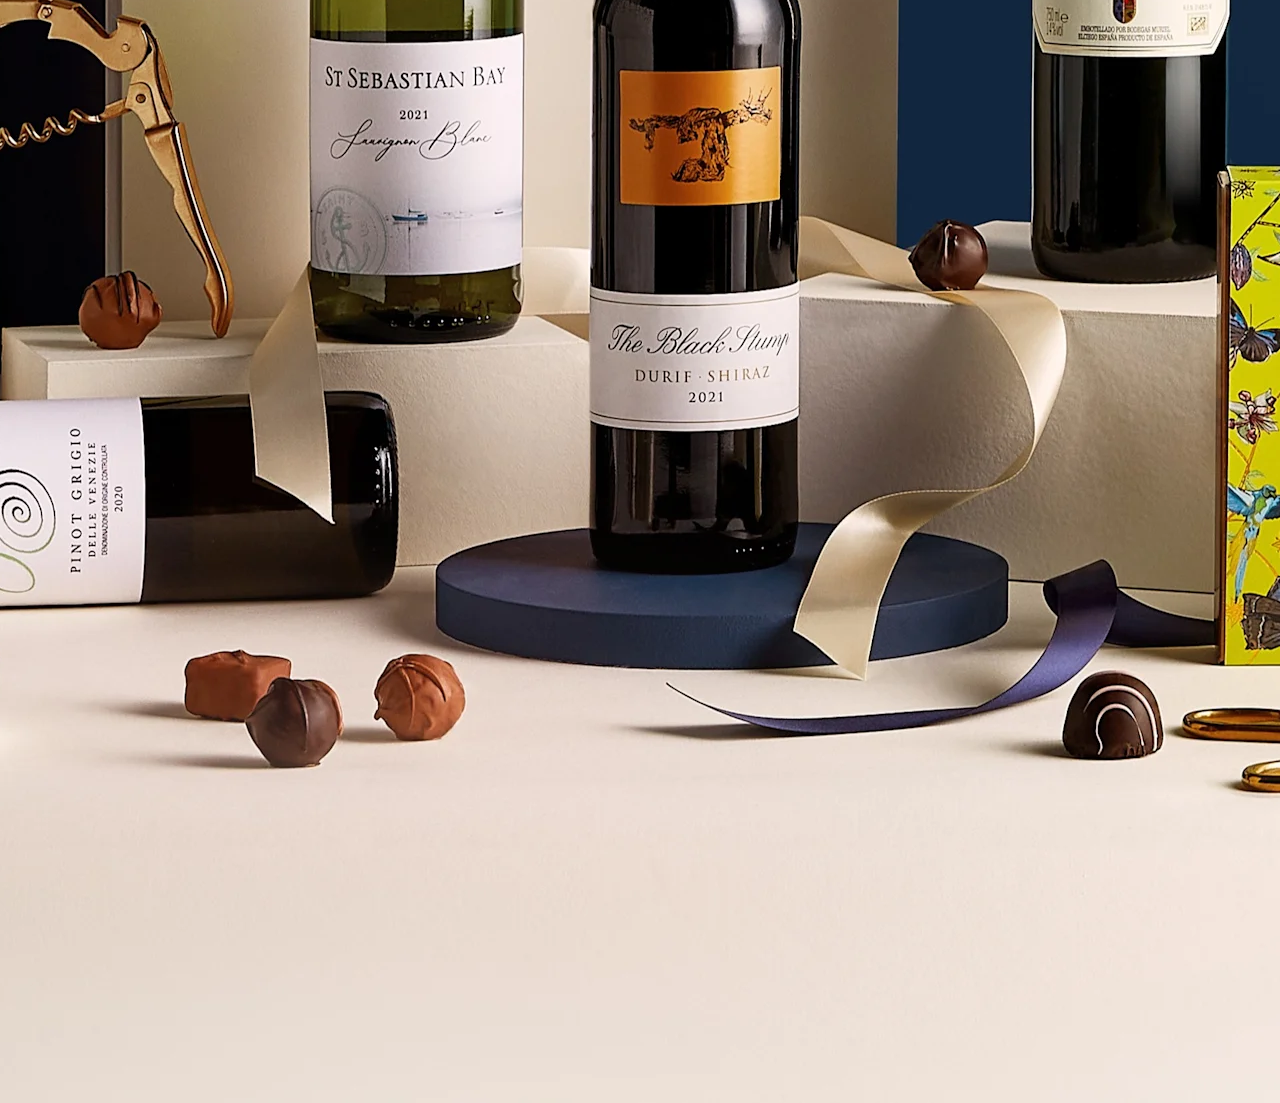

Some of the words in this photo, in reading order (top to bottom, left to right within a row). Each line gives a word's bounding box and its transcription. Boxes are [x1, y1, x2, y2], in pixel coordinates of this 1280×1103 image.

[347, 68, 465, 90] SEBASTIAN
[472, 66, 506, 88] BAY
[399, 109, 429, 121] 2021
[330, 119, 420, 162] Sauvignon
[419, 120, 492, 160] Blanc
[607, 324, 644, 353] The
[647, 325, 733, 355] Black
[728, 323, 791, 357] Stump
[635, 369, 692, 383] DURIF
[708, 366, 771, 383] SHIRAZ
[689, 391, 724, 403] 2021
[70, 428, 82, 500] GRIGIO
[88, 442, 97, 505] VENEZIE
[114, 486, 123, 513] 2020
[70, 513, 82, 574] PINOT
[88, 513, 97, 558] DELLE
